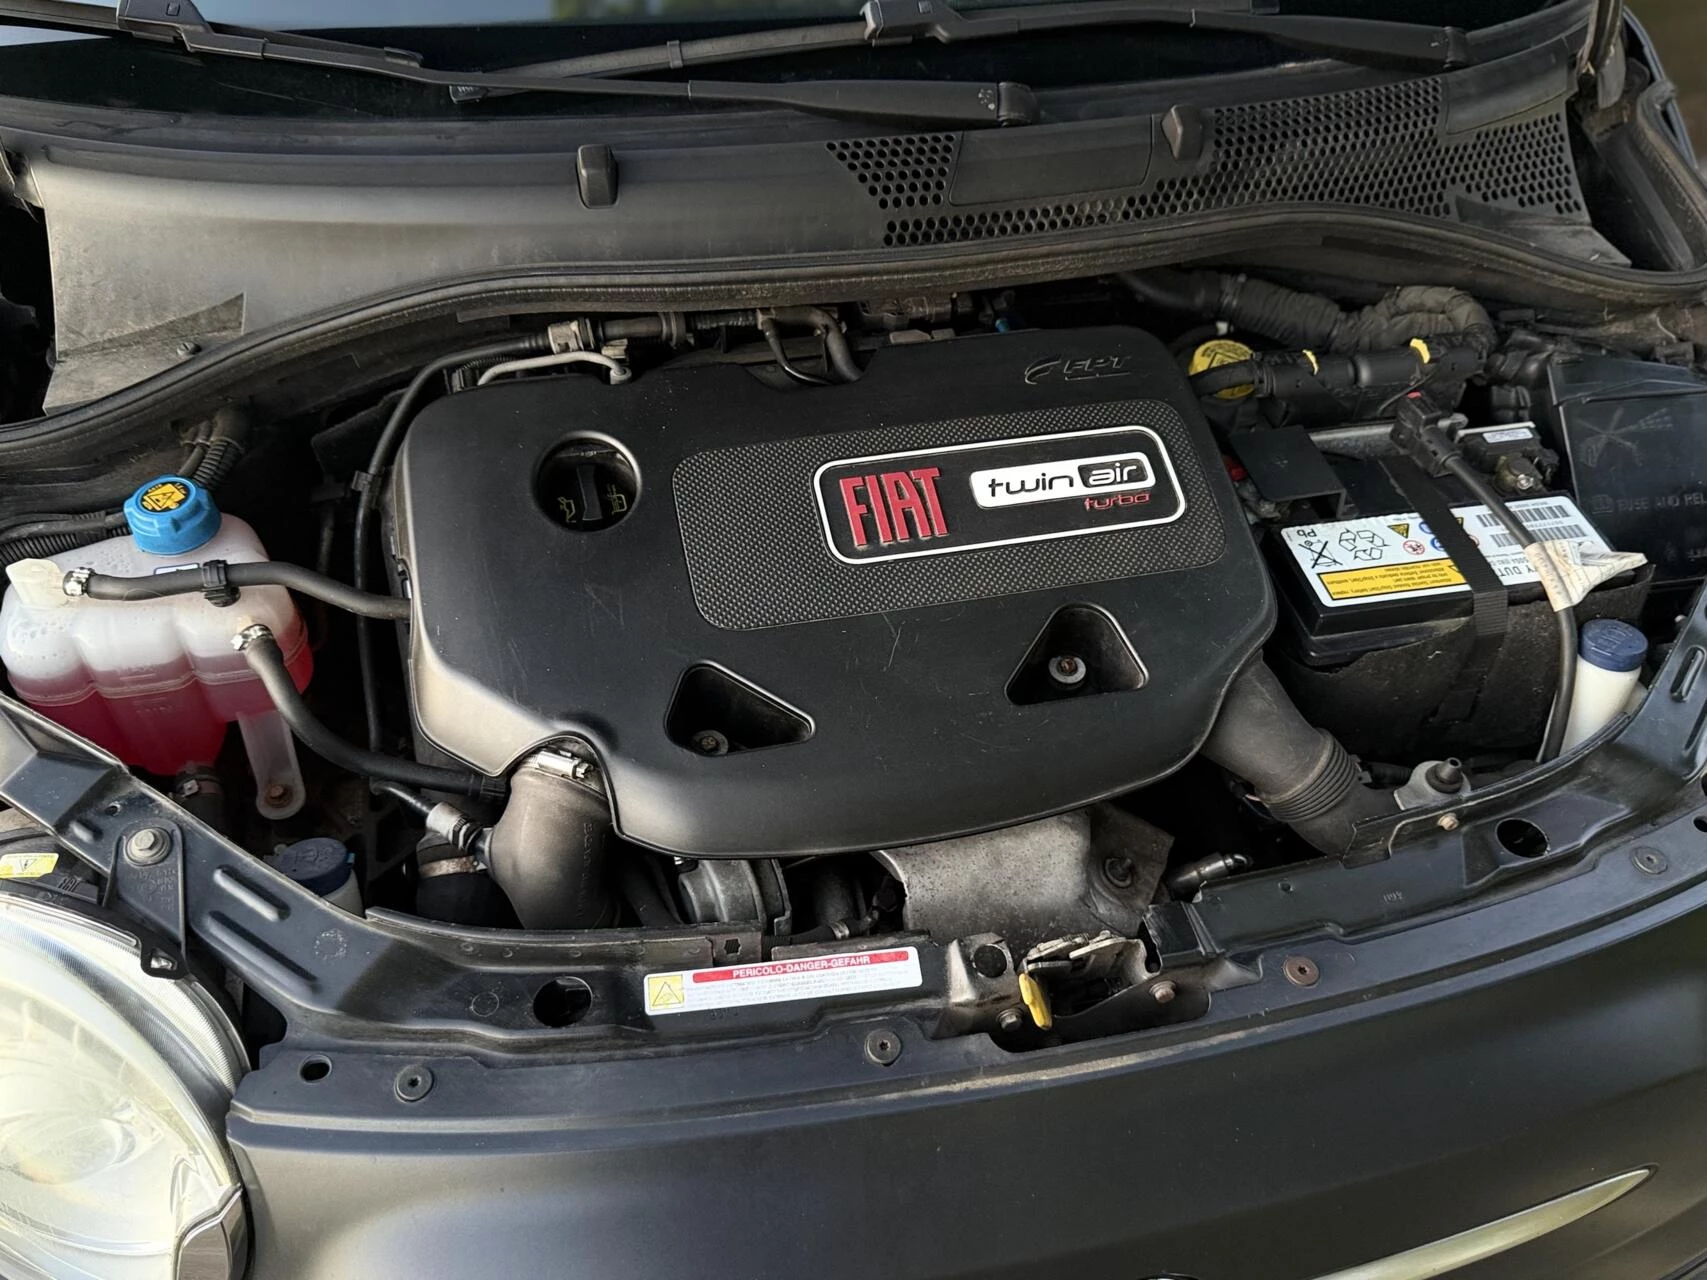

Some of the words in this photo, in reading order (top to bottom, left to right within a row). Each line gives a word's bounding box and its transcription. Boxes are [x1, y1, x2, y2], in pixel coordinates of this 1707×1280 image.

[988, 472, 1074, 498] twin
[1089, 462, 1137, 486] air
[839, 466, 949, 547] FIAT
[1083, 491, 1150, 511] turbo
[1296, 528, 1317, 539] Pb
[1498, 565, 1522, 577] DUT
[732, 955, 871, 979] PERICOLO-DANGER-GEFAHR
